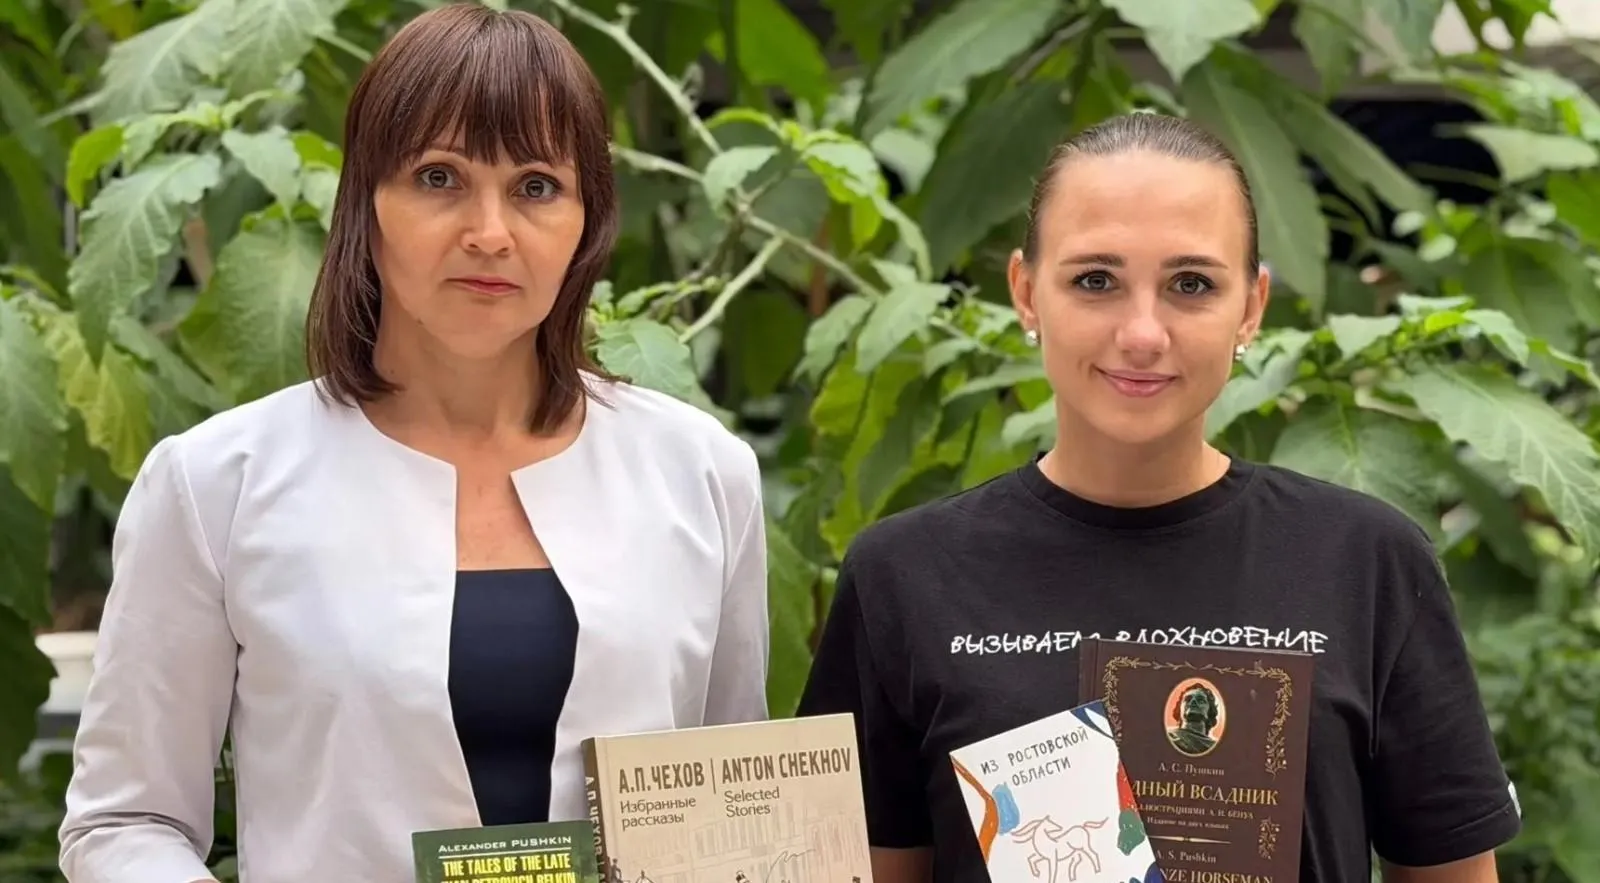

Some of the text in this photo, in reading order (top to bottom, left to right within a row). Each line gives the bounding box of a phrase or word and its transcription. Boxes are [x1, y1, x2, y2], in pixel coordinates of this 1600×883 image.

[980, 726, 1089, 775] ИЗ РОСТОВСКОЙ
[722, 747, 851, 784] ANTON CHEKHOV
[1012, 756, 1071, 786] ОБЛАСТИ
[1158, 762, 1225, 776] А. С. Пушкин
[619, 761, 705, 794] А.П.ЧЕХОВ
[724, 786, 780, 803] Selected
[1132, 779, 1279, 806] ДНЫЙ ВСАДНИК
[620, 797, 696, 815] Избранные
[726, 803, 771, 819] Stories
[622, 813, 685, 831] рассказы
[438, 836, 572, 853] ALEXANDER PUSHKIN
[443, 853, 572, 877] THE TALES OF THE LATE
[1180, 851, 1217, 864] Pushkin
[1160, 868, 1273, 883] NZE HORSEMAN
